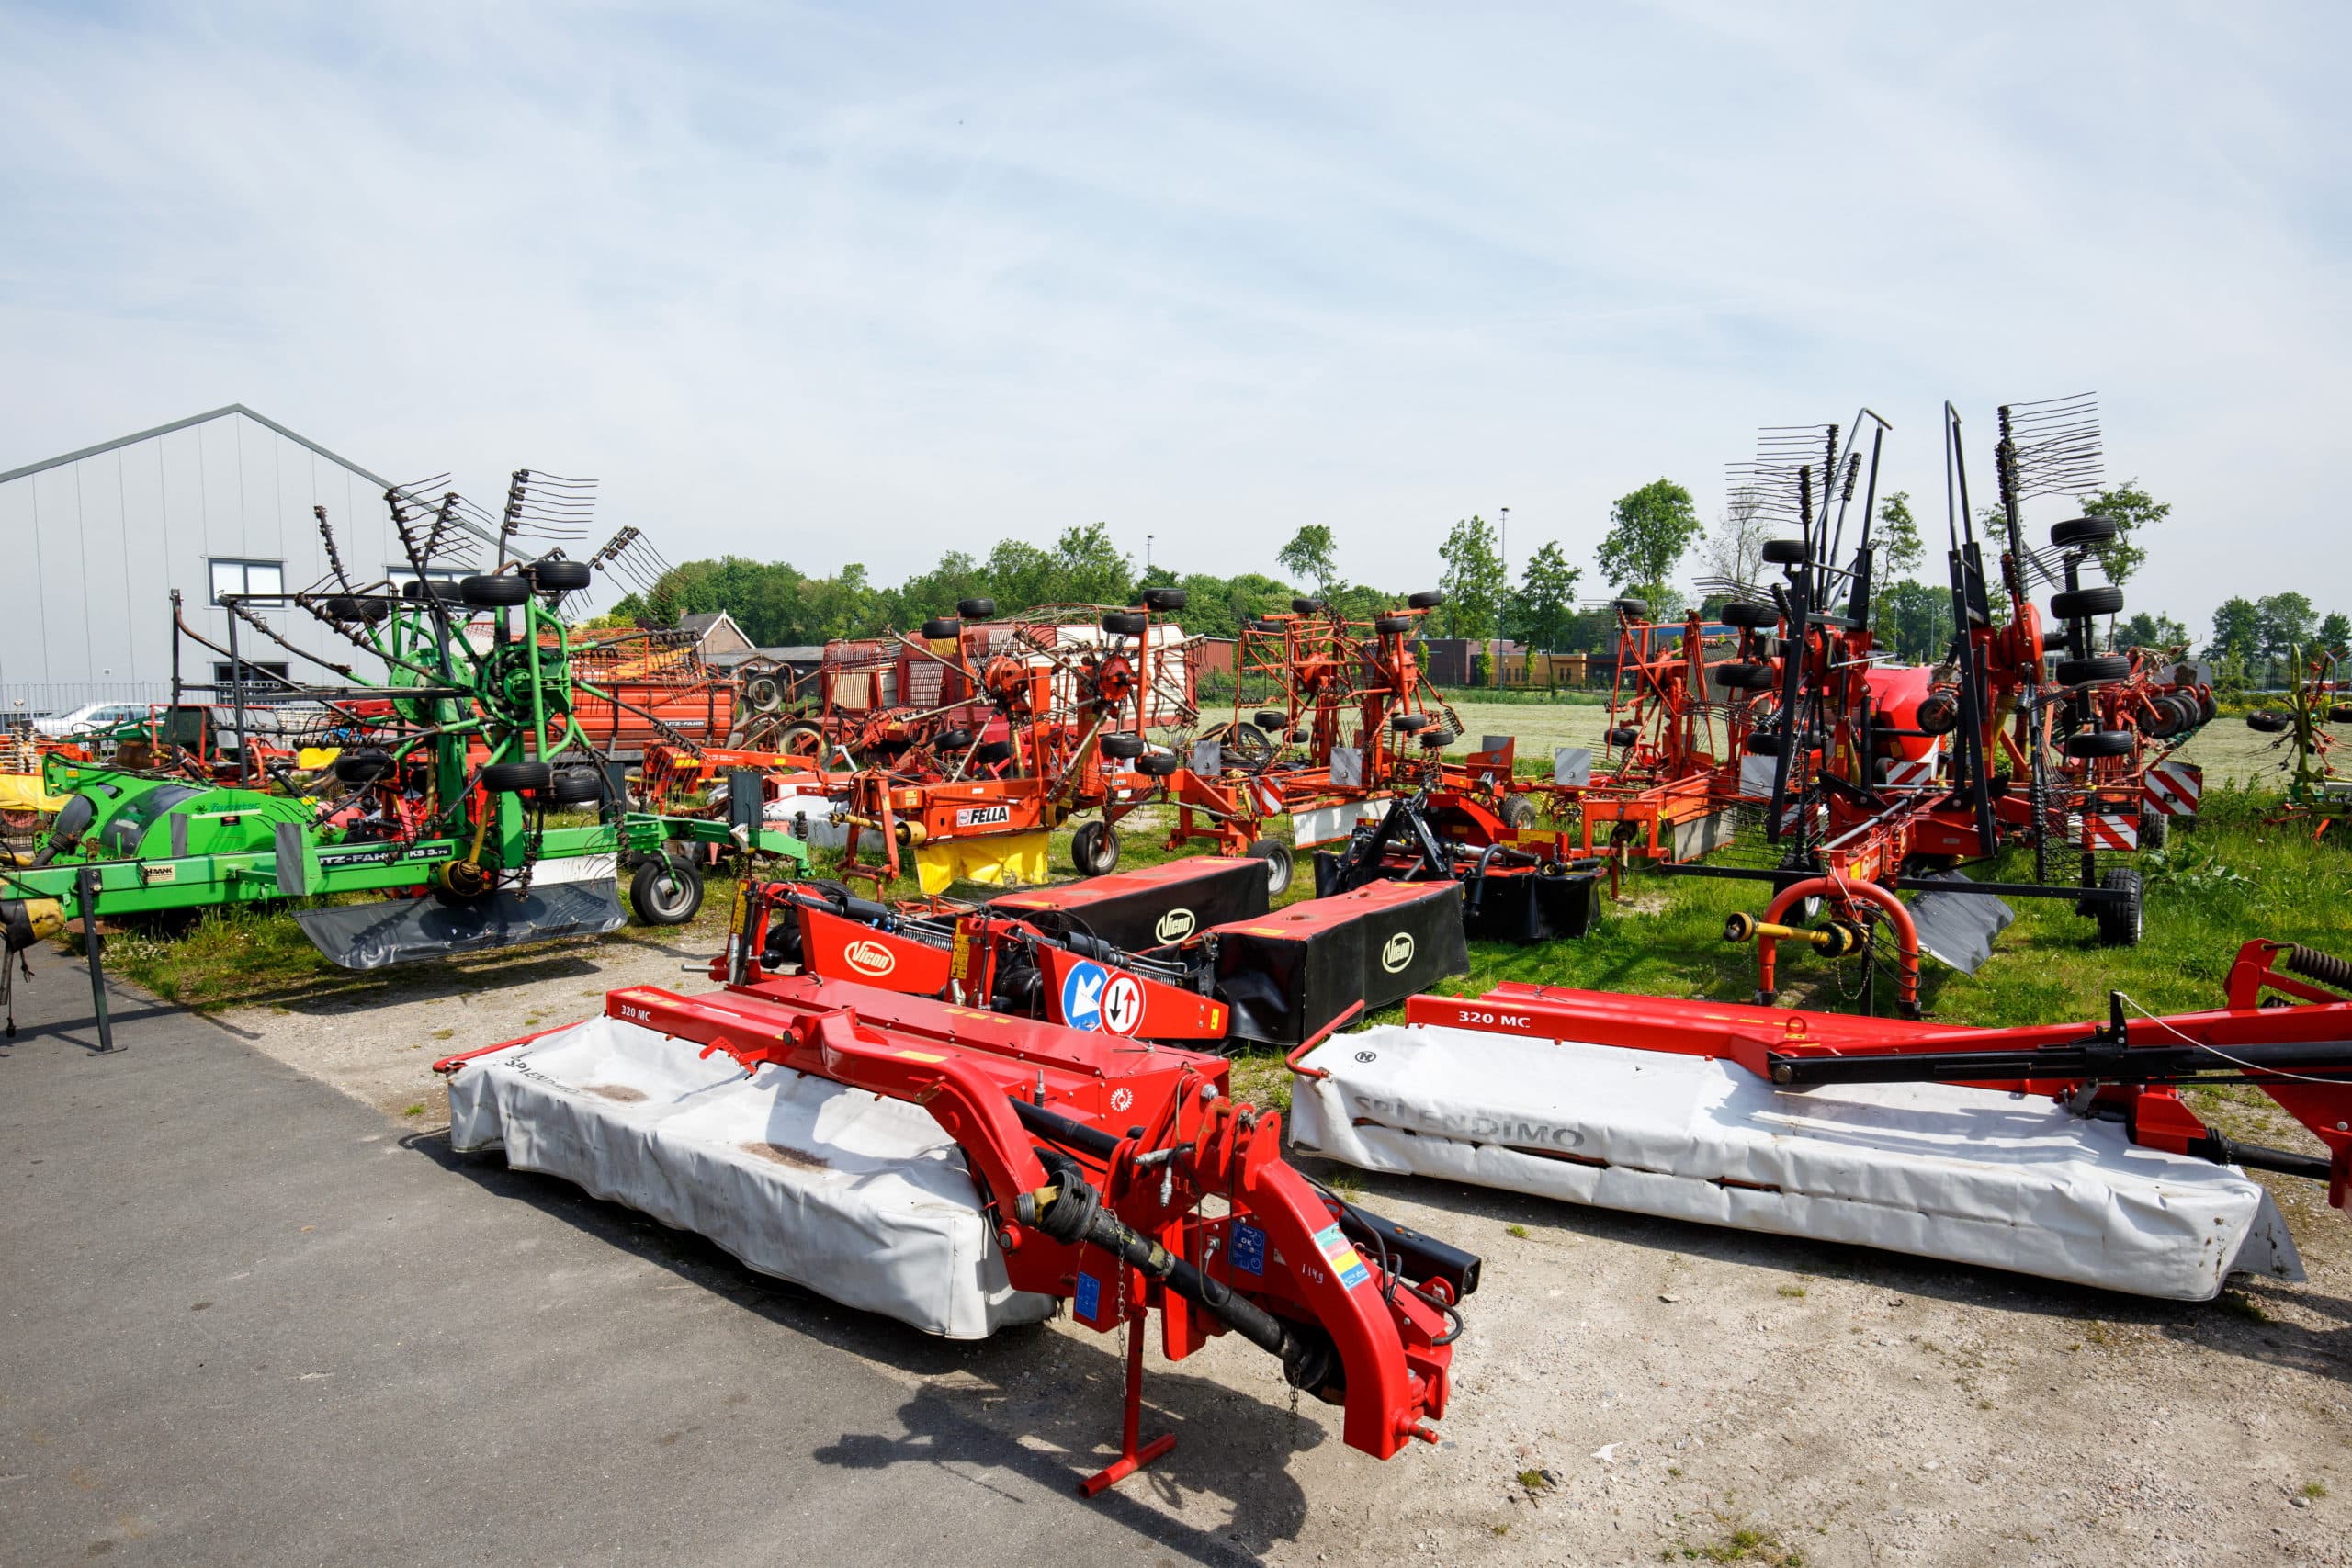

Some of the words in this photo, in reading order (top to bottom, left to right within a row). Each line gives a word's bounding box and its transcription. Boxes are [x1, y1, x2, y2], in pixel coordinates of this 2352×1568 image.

[970, 807, 1008, 824] FELLA
[409, 849, 425, 857] KS
[1160, 913, 1192, 938] Vicon
[851, 941, 890, 969] Vicon
[1386, 937, 1411, 964] Vicon
[620, 1004, 636, 1018] 320
[638, 1009, 651, 1022] MC
[1458, 1010, 1495, 1024] 320
[1500, 1015, 1531, 1029] MC
